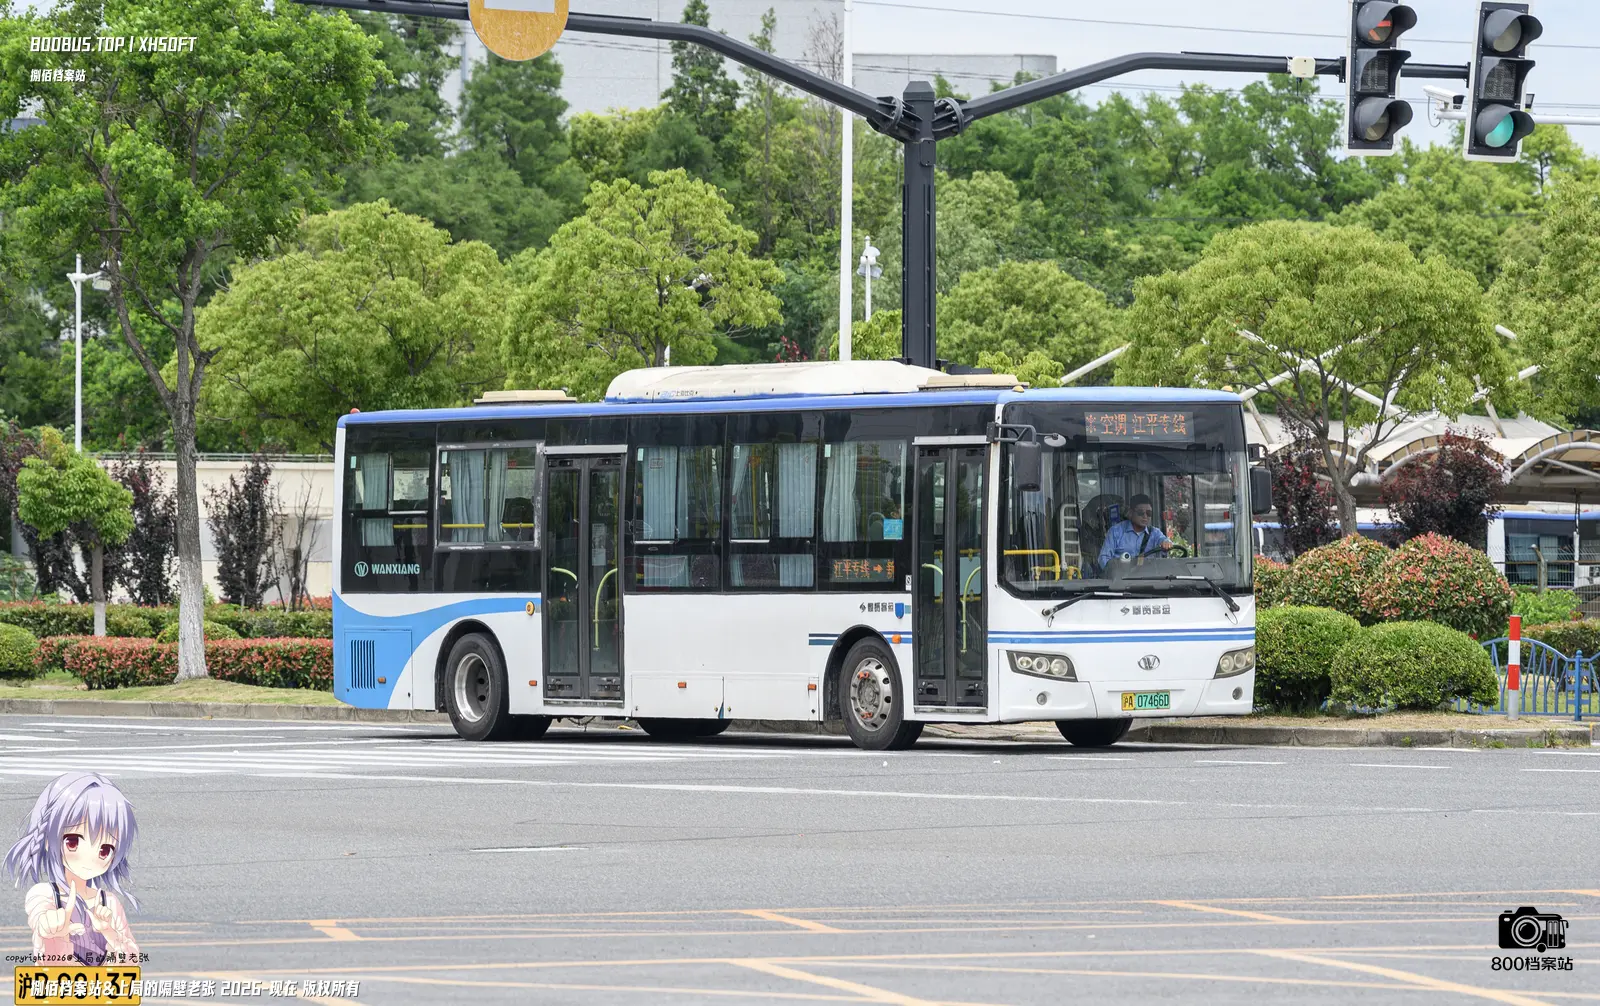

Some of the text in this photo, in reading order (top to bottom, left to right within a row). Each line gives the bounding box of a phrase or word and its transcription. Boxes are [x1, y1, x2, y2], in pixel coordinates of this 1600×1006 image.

[1099, 413, 1187, 435] 空调 江平专线
[371, 563, 420, 574] WANXIANG
[1137, 694, 1170, 708] 07466D
